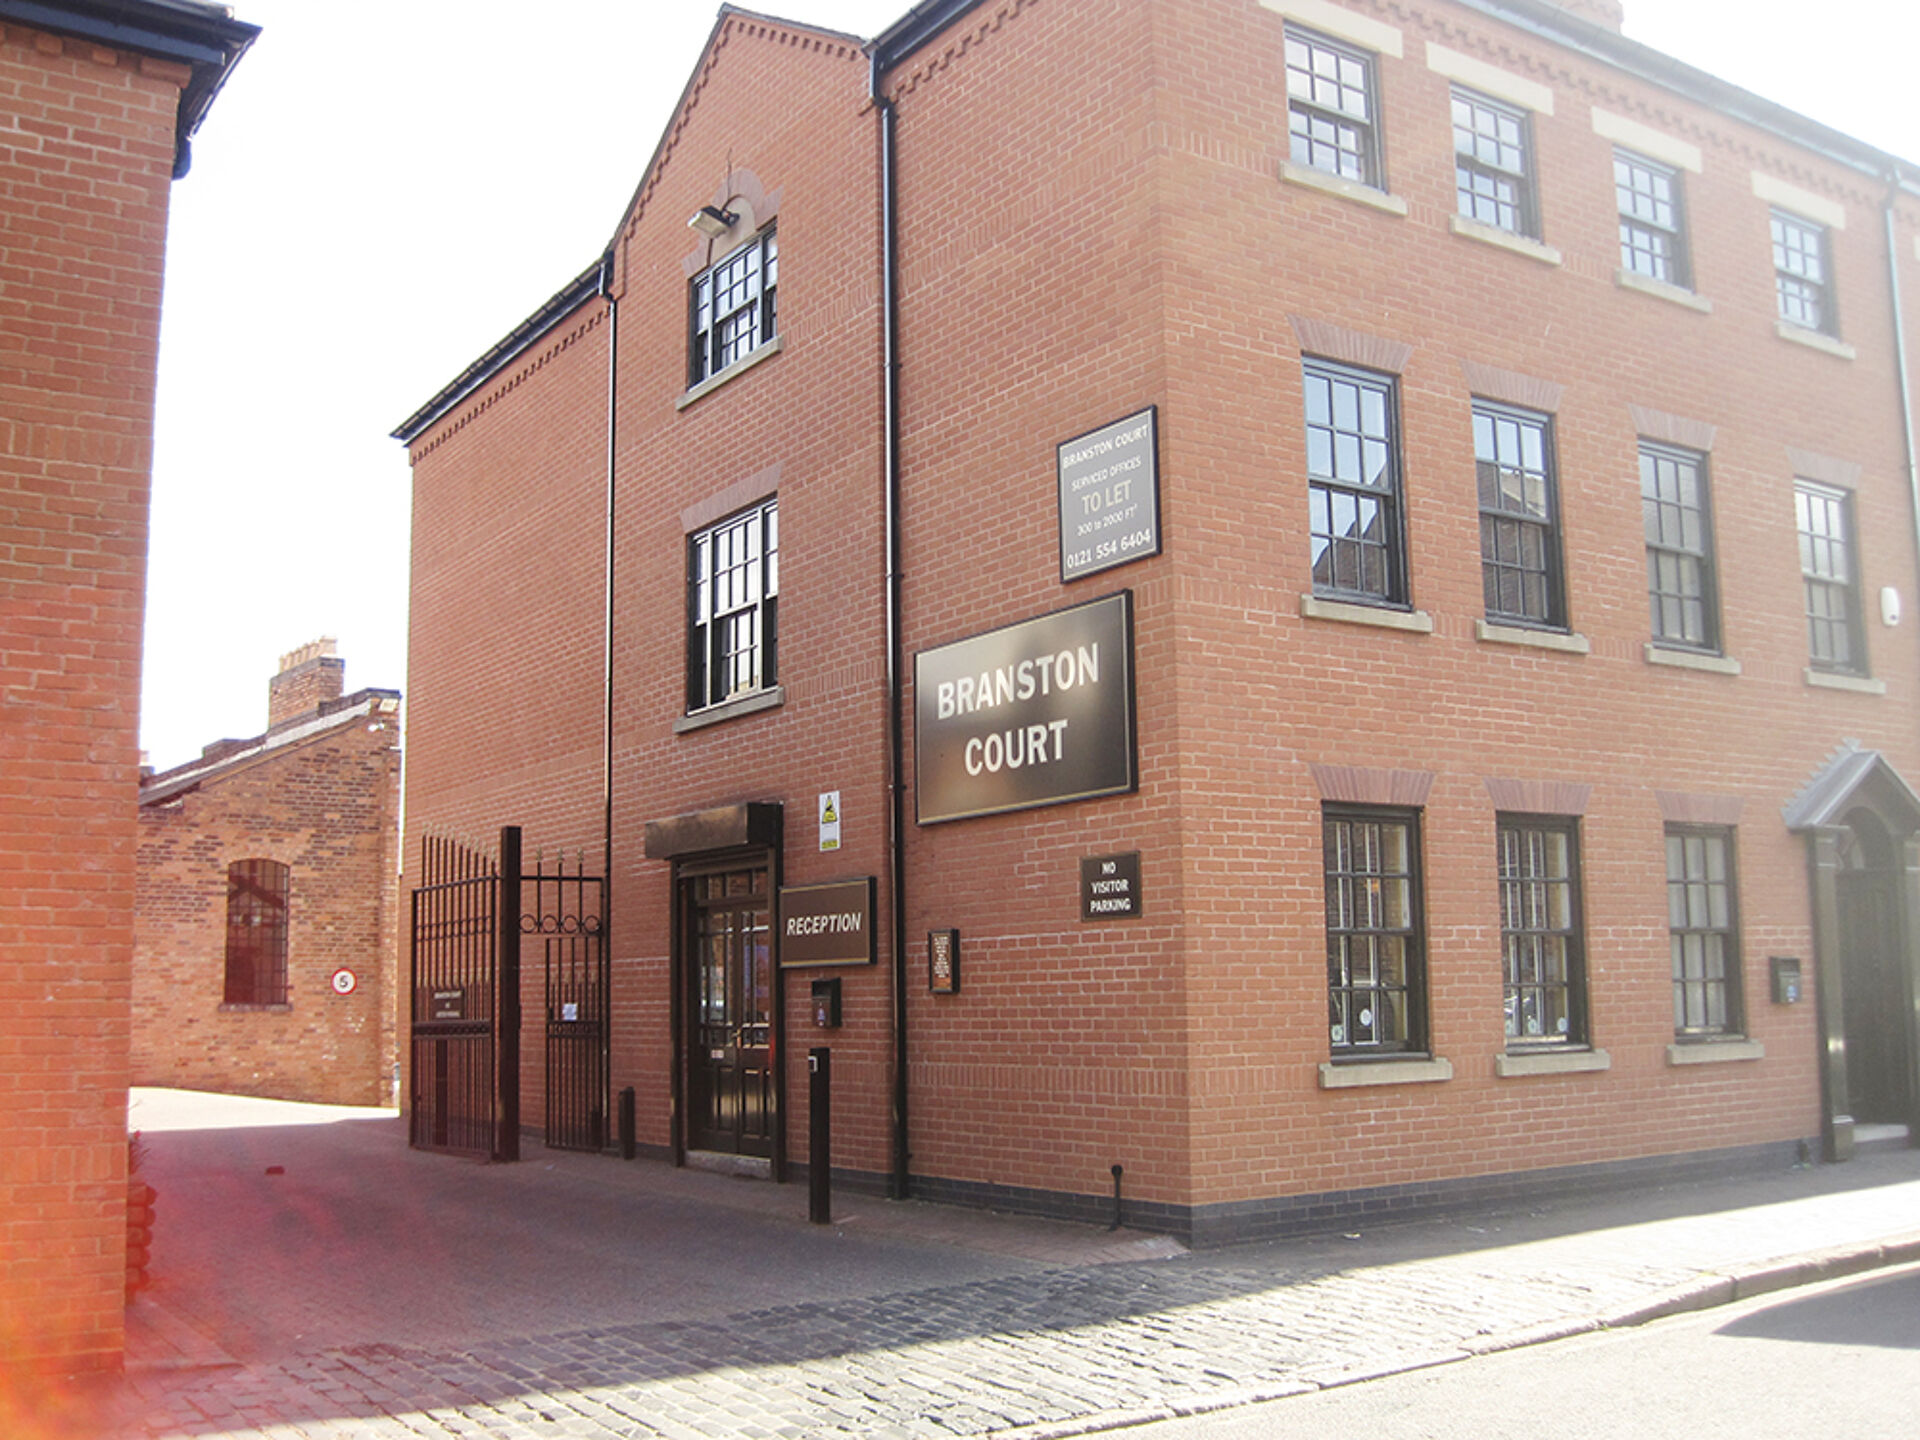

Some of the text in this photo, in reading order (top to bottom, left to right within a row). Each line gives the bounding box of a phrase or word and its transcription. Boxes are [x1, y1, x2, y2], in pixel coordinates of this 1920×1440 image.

[1063, 424, 1149, 469] BRANSTON COURT
[1072, 455, 1142, 492] SERVICED OFFICES
[1081, 480, 1132, 515] TO LET
[1103, 510, 1123, 528] 2000
[1067, 528, 1151, 569] 0121 554 6404
[937, 643, 1099, 720] BRANSTON
[965, 719, 1069, 777] COURT
[1102, 861, 1117, 875] NO
[1091, 879, 1130, 894] VISITOR
[1090, 898, 1132, 913] PARKING
[786, 912, 862, 936] RECEPTION
[340, 975, 348, 988] 5
